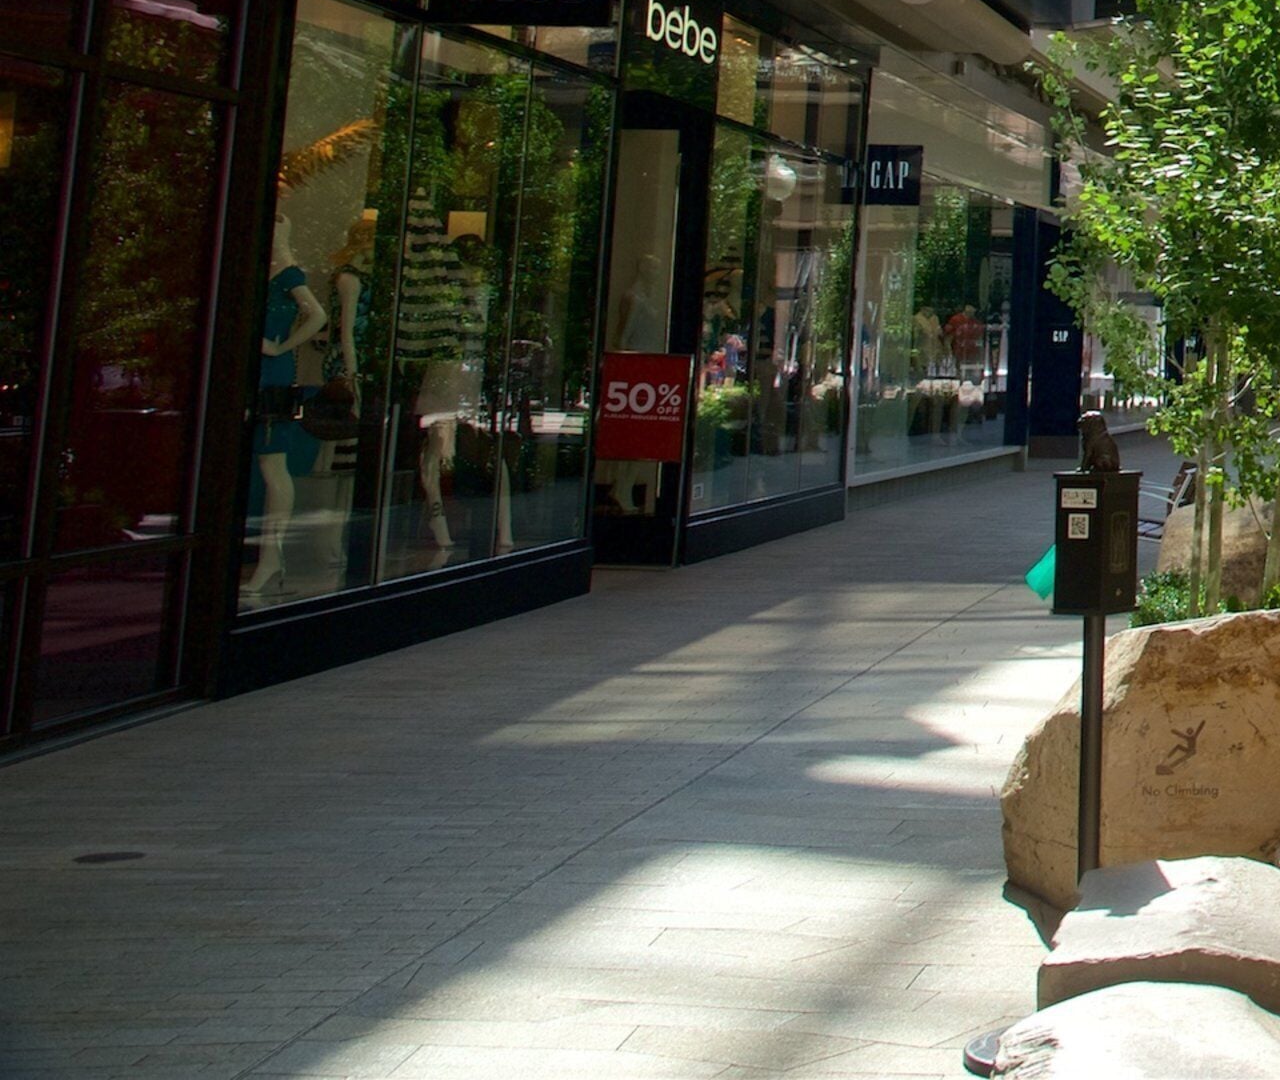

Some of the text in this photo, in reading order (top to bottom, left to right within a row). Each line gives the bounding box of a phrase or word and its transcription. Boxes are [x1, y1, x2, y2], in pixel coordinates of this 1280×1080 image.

[870, 160, 909, 189] GAP
[605, 381, 682, 414] 50%
[656, 406, 680, 415] OFF
[1142, 783, 1219, 799] No Climbing
